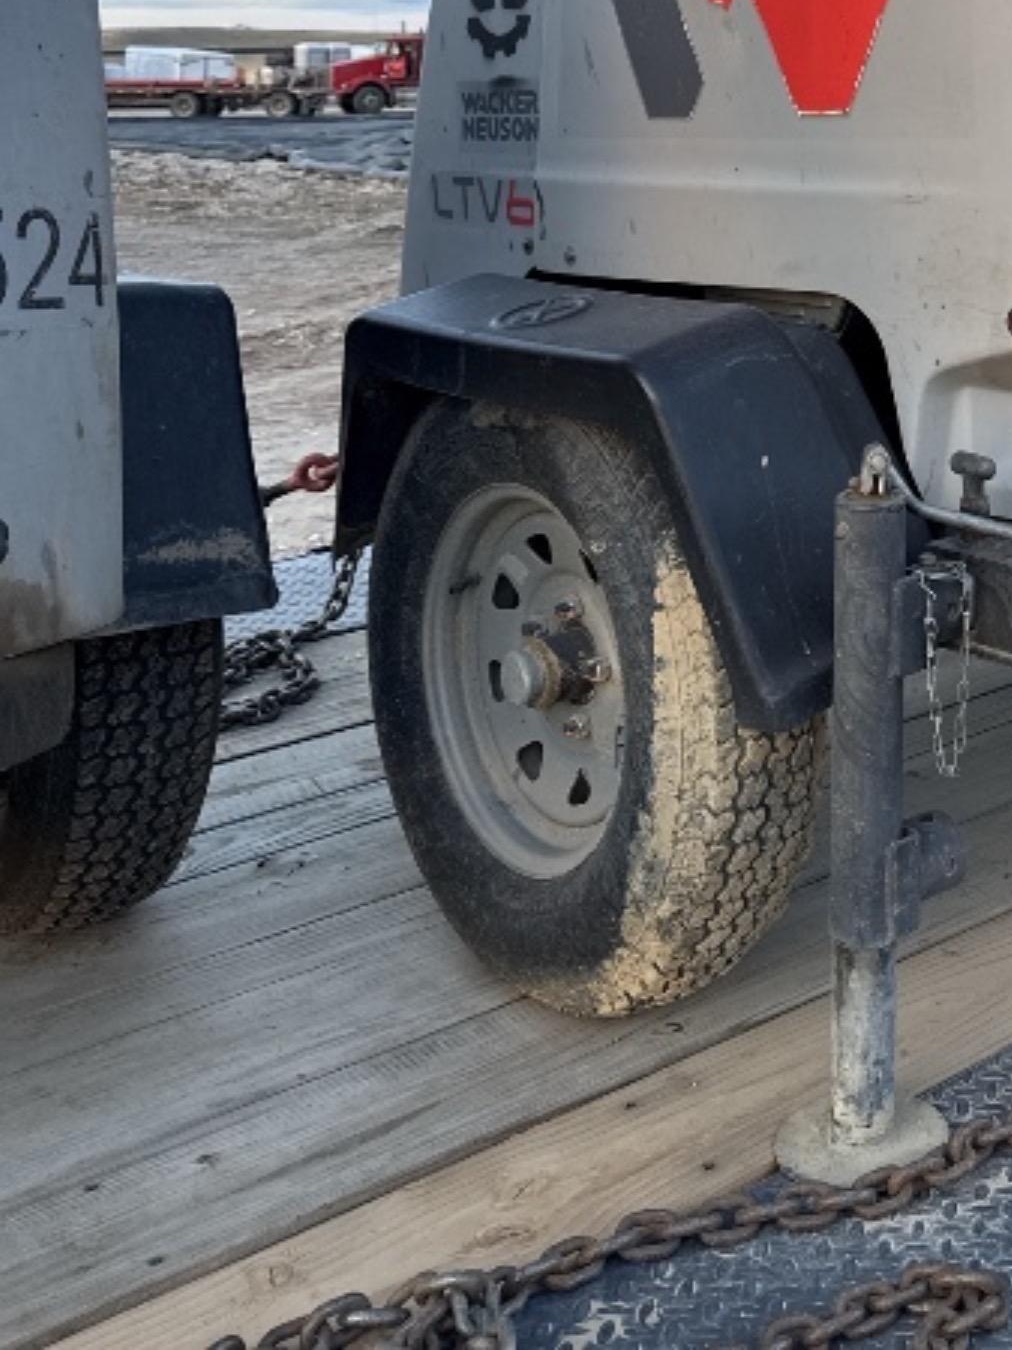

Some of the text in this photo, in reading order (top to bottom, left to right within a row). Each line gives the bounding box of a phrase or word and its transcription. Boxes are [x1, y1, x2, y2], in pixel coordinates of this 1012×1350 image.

[461, 89, 540, 116] WACKER
[462, 116, 541, 143] NEUSON
[0, 207, 107, 310] 24
